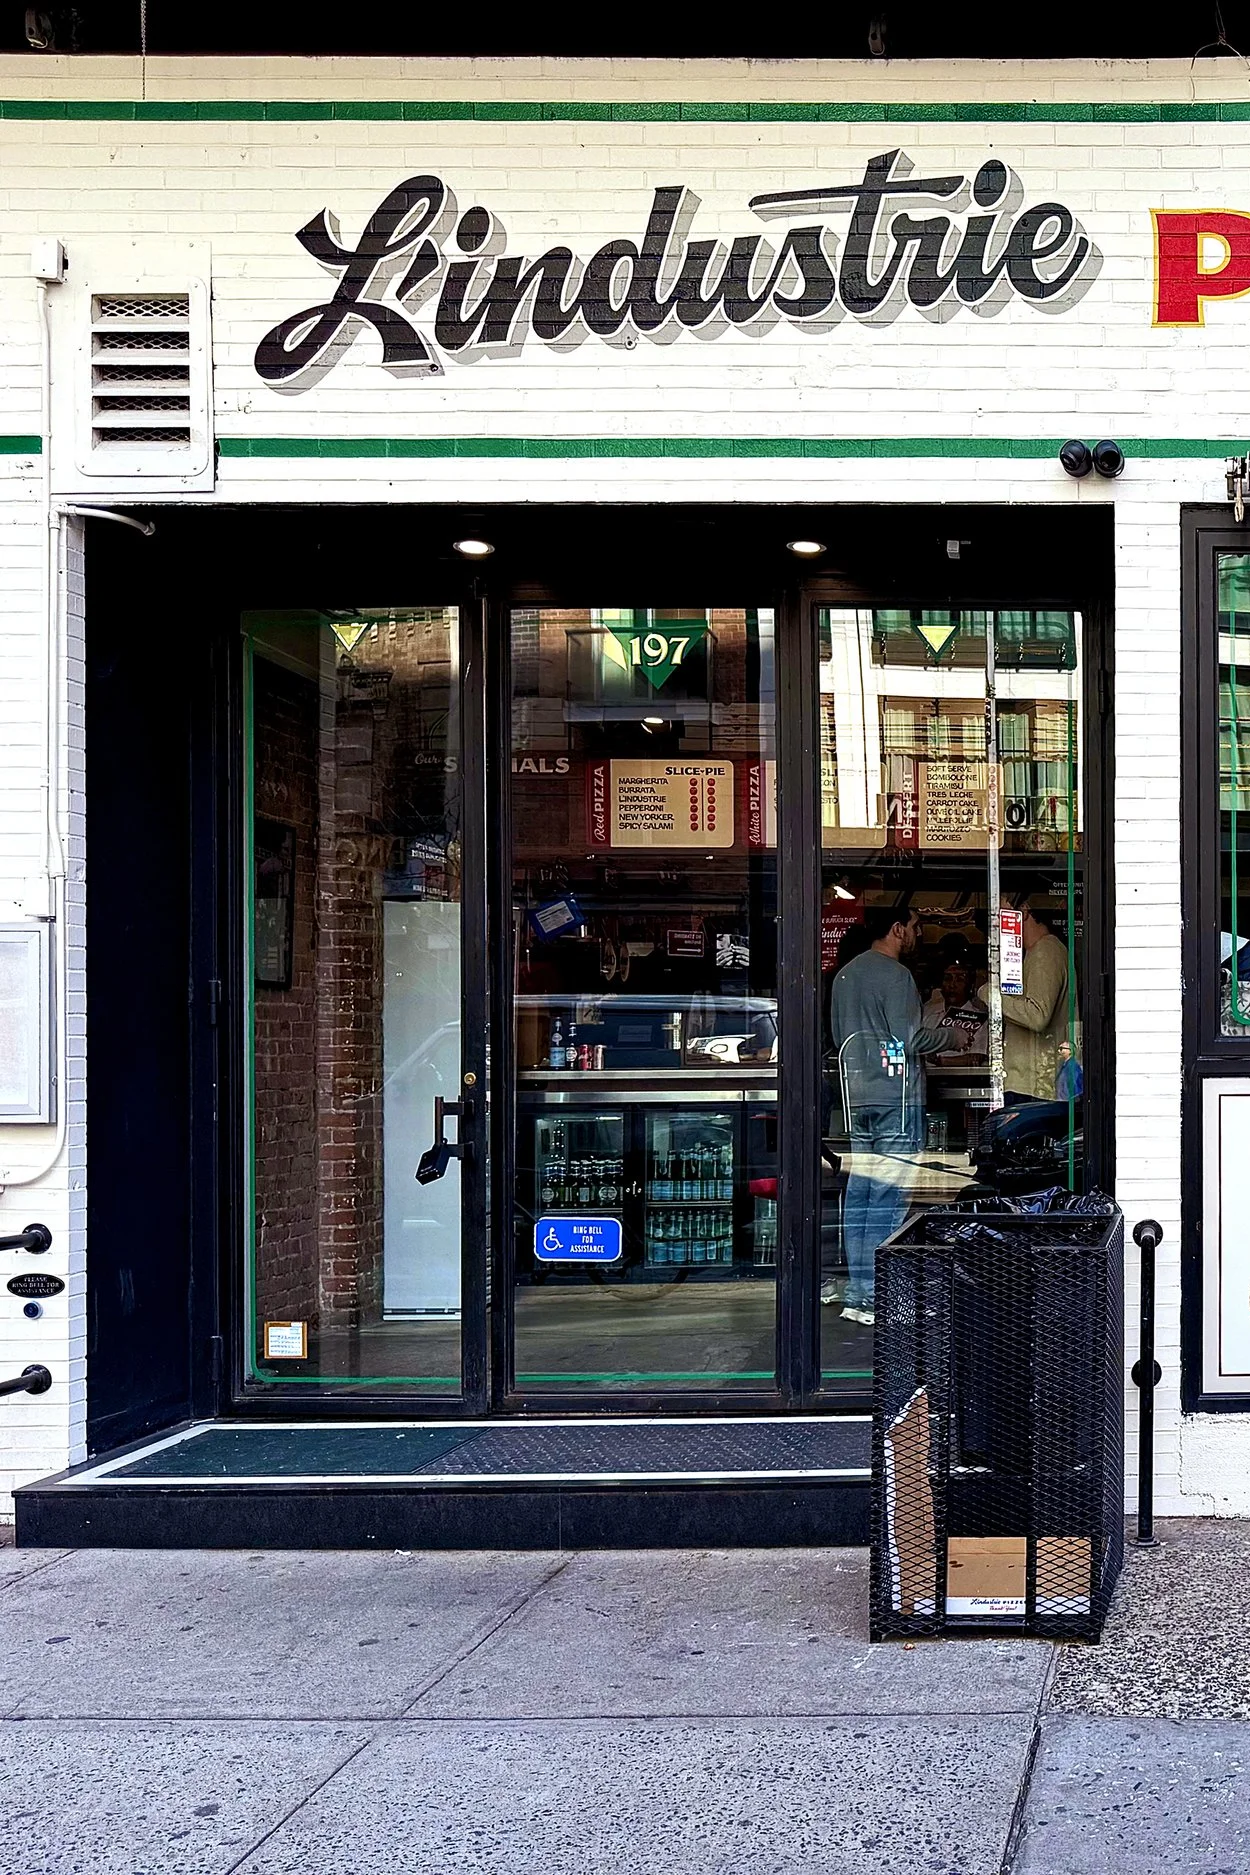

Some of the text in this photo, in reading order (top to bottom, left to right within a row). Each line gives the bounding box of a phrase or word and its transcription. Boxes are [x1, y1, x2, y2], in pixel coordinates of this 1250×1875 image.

[628, 632, 691, 668] 197
[705, 767, 725, 775] PIE
[947, 765, 972, 773] SERVE
[618, 777, 669, 785] MARGHERITA
[618, 786, 655, 794] BURRATA
[593, 766, 605, 841] Red PIZZA
[748, 765, 760, 845] White PIZZA
[926, 799, 979, 807] CARROT CAKE
[618, 804, 664, 812] PEPPERONI
[618, 813, 675, 821] NEW YORKER
[618, 822, 674, 830] SPICY SALAMI
[926, 833, 962, 841] COOKIES
[572, 1225, 603, 1234] RING BELL
[582, 1235, 594, 1244] FOR
[569, 1244, 605, 1253] ASSISTANCE
